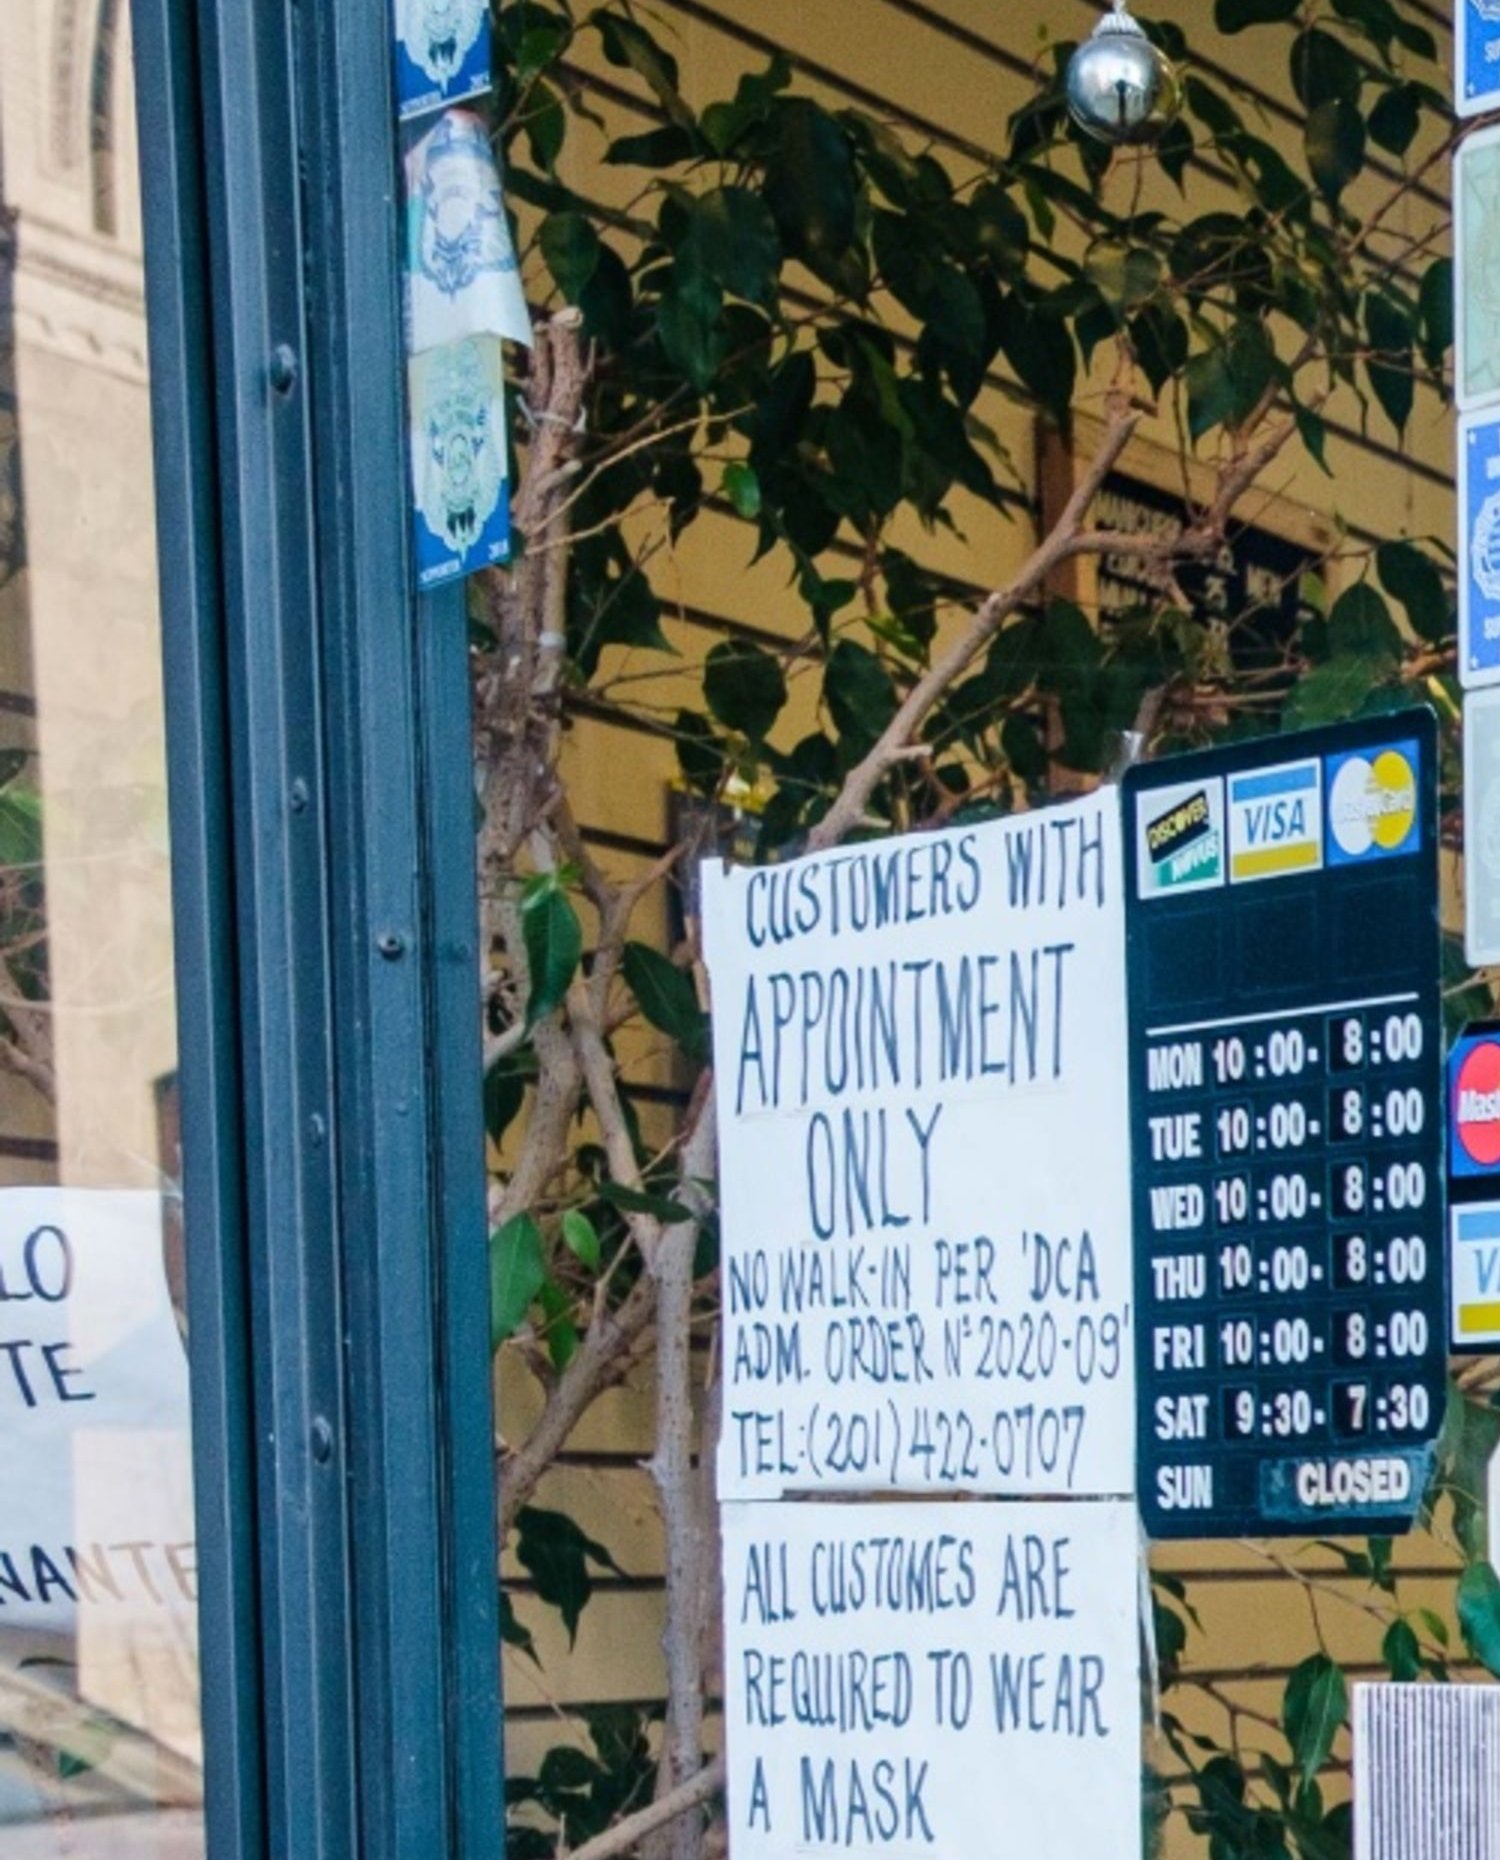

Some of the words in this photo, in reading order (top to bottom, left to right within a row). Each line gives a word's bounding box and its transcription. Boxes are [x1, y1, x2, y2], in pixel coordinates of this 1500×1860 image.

[1244, 798, 1306, 845] VISA
[746, 835, 980, 947] CUSTOMERS
[1005, 810, 1107, 909] WITH
[736, 944, 1075, 1114] APPOINTMENT
[1148, 1044, 1202, 1091] MON
[1149, 1114, 1201, 1160] TUE
[806, 1103, 942, 1241] ONLY
[1151, 1184, 1203, 1230] WED
[729, 1249, 768, 1314] NO
[780, 1243, 911, 1312] WALK-IN
[935, 1235, 997, 1308] PER
[1152, 1255, 1206, 1300] THU
[733, 1320, 811, 1385] ADM.
[825, 1312, 934, 1385] ORDER
[1153, 1325, 1206, 1370] FRI
[1155, 1396, 1208, 1440] SAT
[1157, 1465, 1213, 1510] SUN
[1297, 1458, 1410, 1505] CLOSED
[740, 1541, 797, 1624] ALL
[810, 1536, 975, 1618] CUSTOMES
[997, 1535, 1075, 1621] ARE
[744, 1649, 913, 1733] REQUIRED
[927, 1650, 971, 1732] TO
[990, 1652, 1108, 1737] WEAR
[748, 1757, 771, 1832] A
[800, 1756, 934, 1846] MASK
